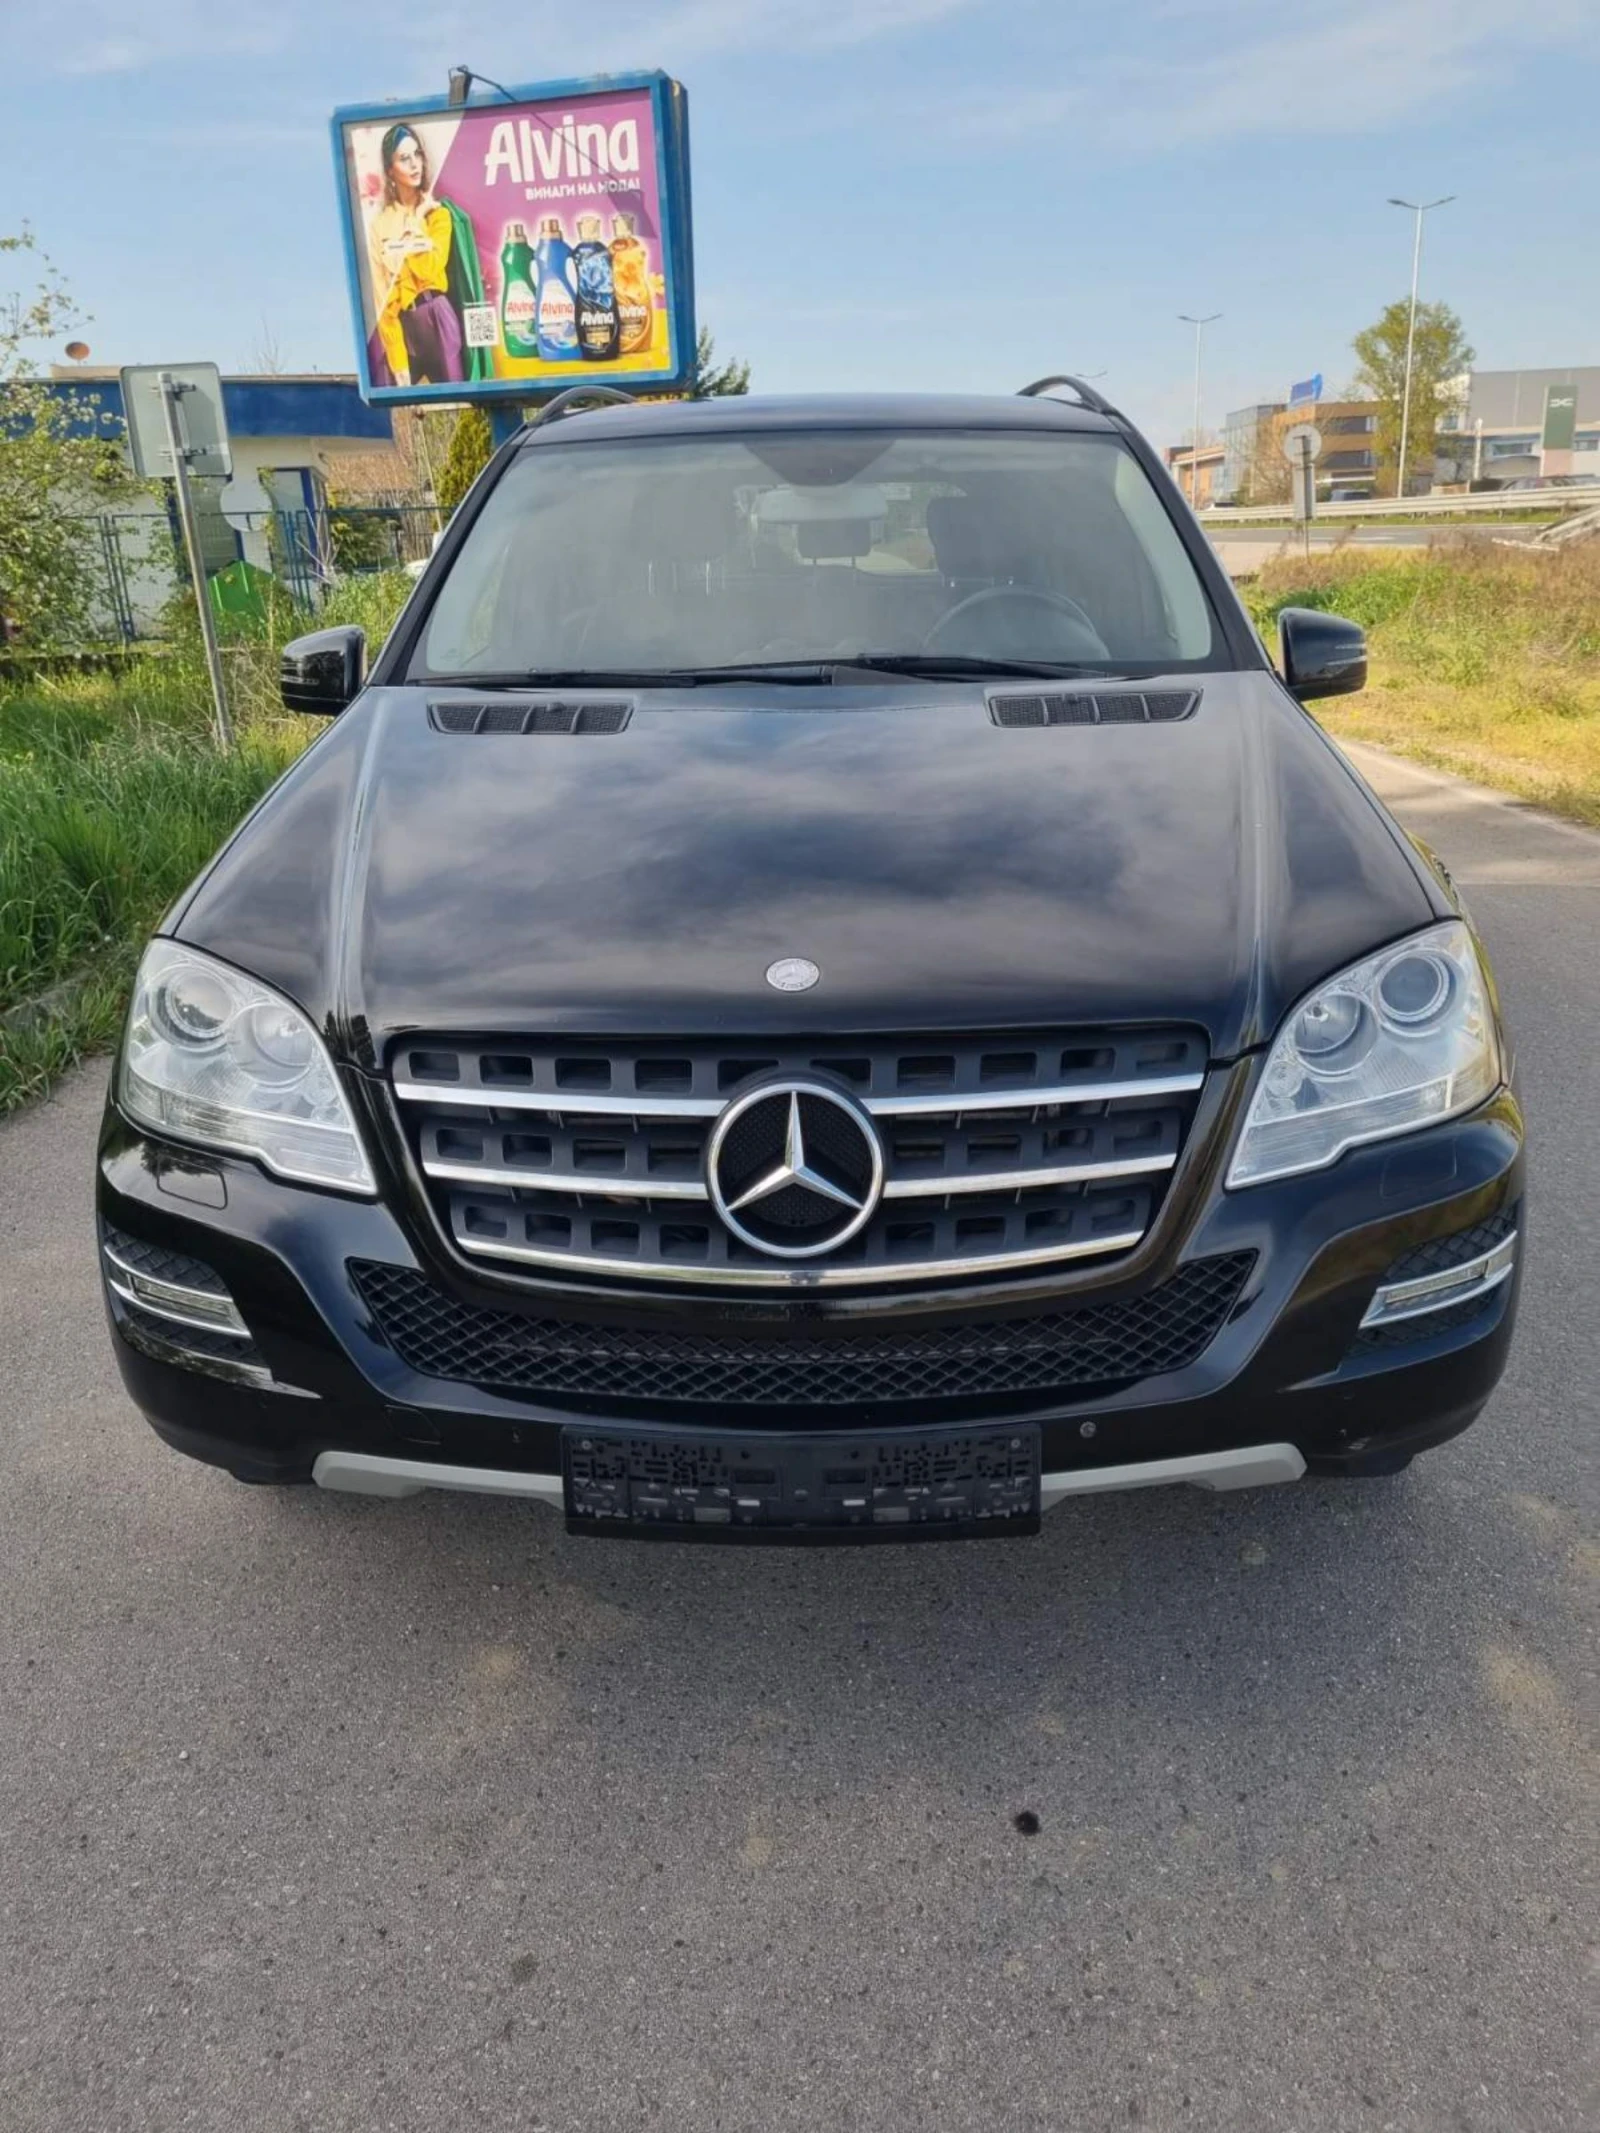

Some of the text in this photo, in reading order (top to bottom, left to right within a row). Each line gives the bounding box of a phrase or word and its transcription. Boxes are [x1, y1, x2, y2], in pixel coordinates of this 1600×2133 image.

[484, 114, 640, 187] Alvina
[525, 183, 576, 201] ВИНАГИ
[577, 181, 597, 196] НА
[541, 302, 574, 315] Alvina
[580, 310, 614, 326] Alvina
